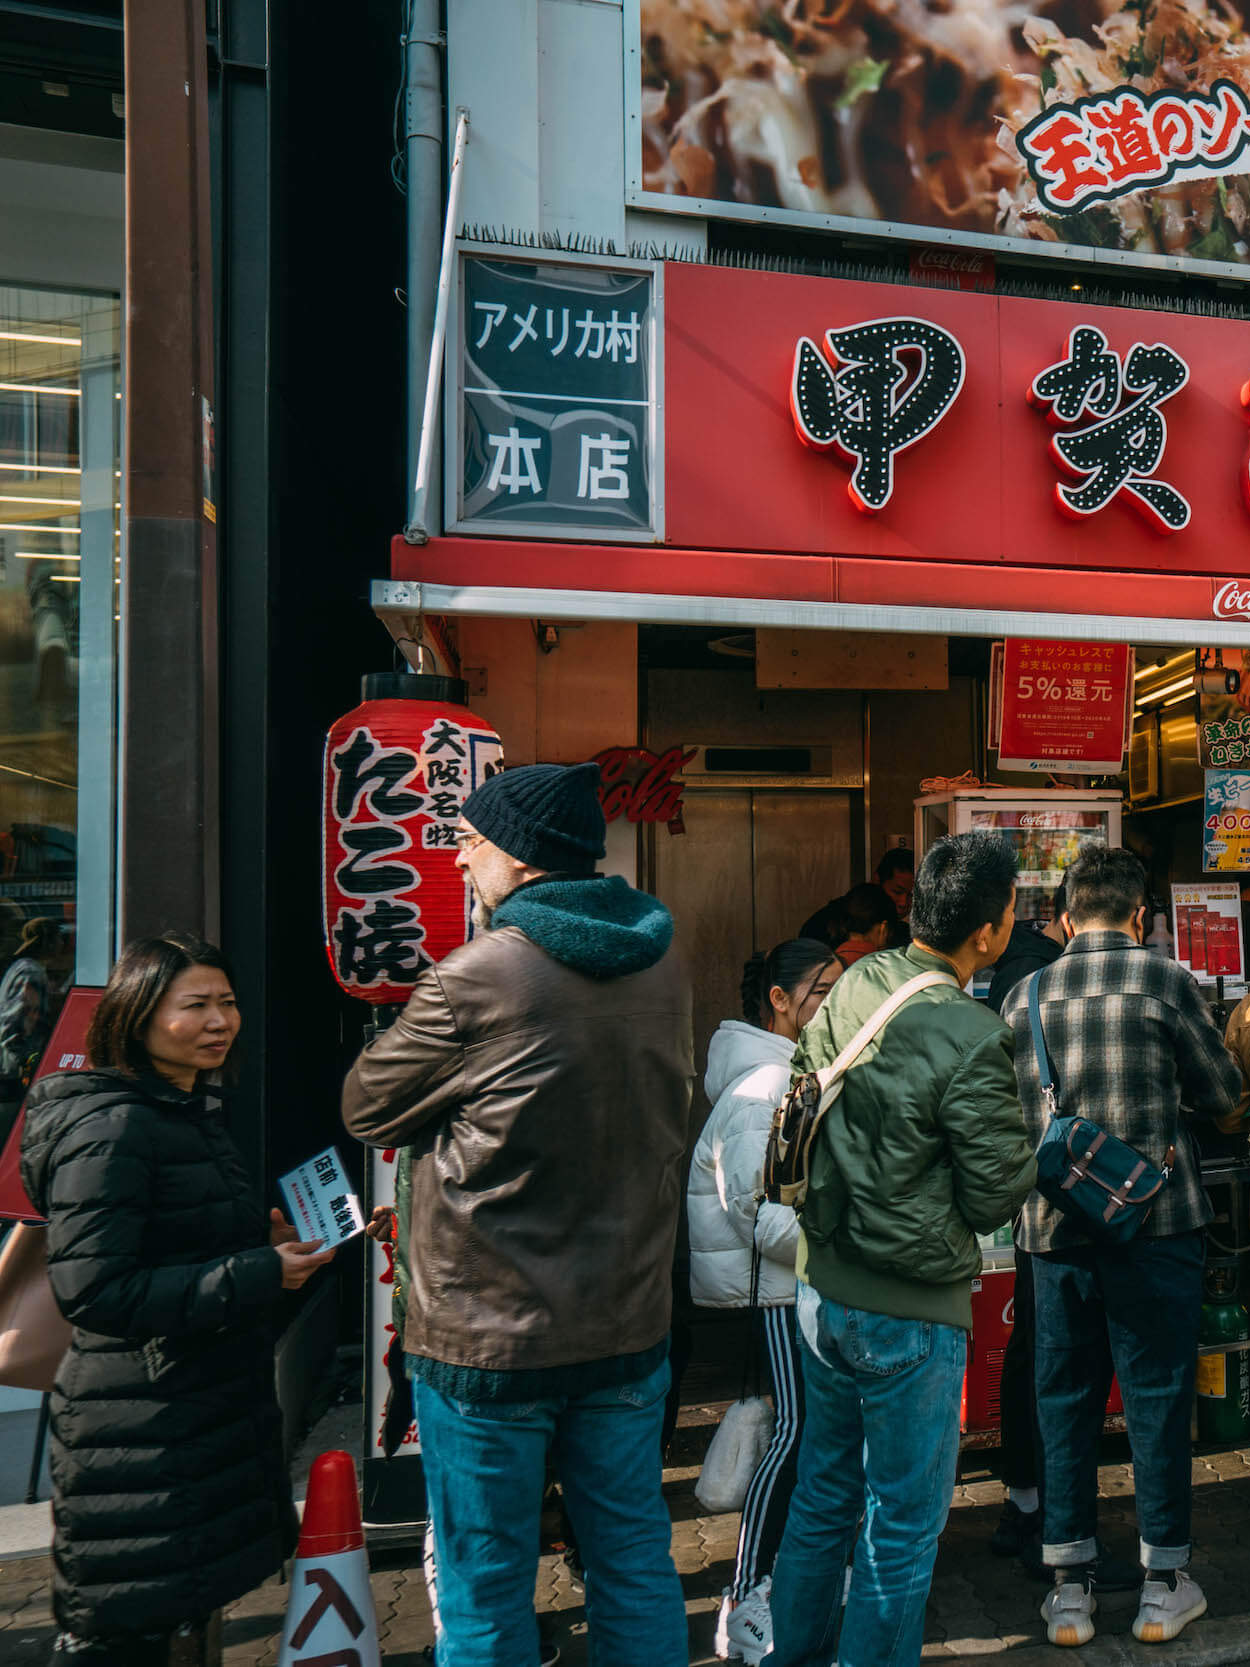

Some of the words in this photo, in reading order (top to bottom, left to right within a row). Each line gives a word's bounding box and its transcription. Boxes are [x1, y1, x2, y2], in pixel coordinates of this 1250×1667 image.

[473, 300, 641, 364] アメリカ村
[486, 427, 631, 500] 本店
[1020, 644, 1115, 659] キャッシュレスで
[1019, 660, 1113, 673] お支払いのお客様に
[1017, 676, 1113, 702] 5%還元
[58, 1054, 73, 1068] UP
[72, 1054, 86, 1069] TO
[290, 1567, 366, 1667] 入
